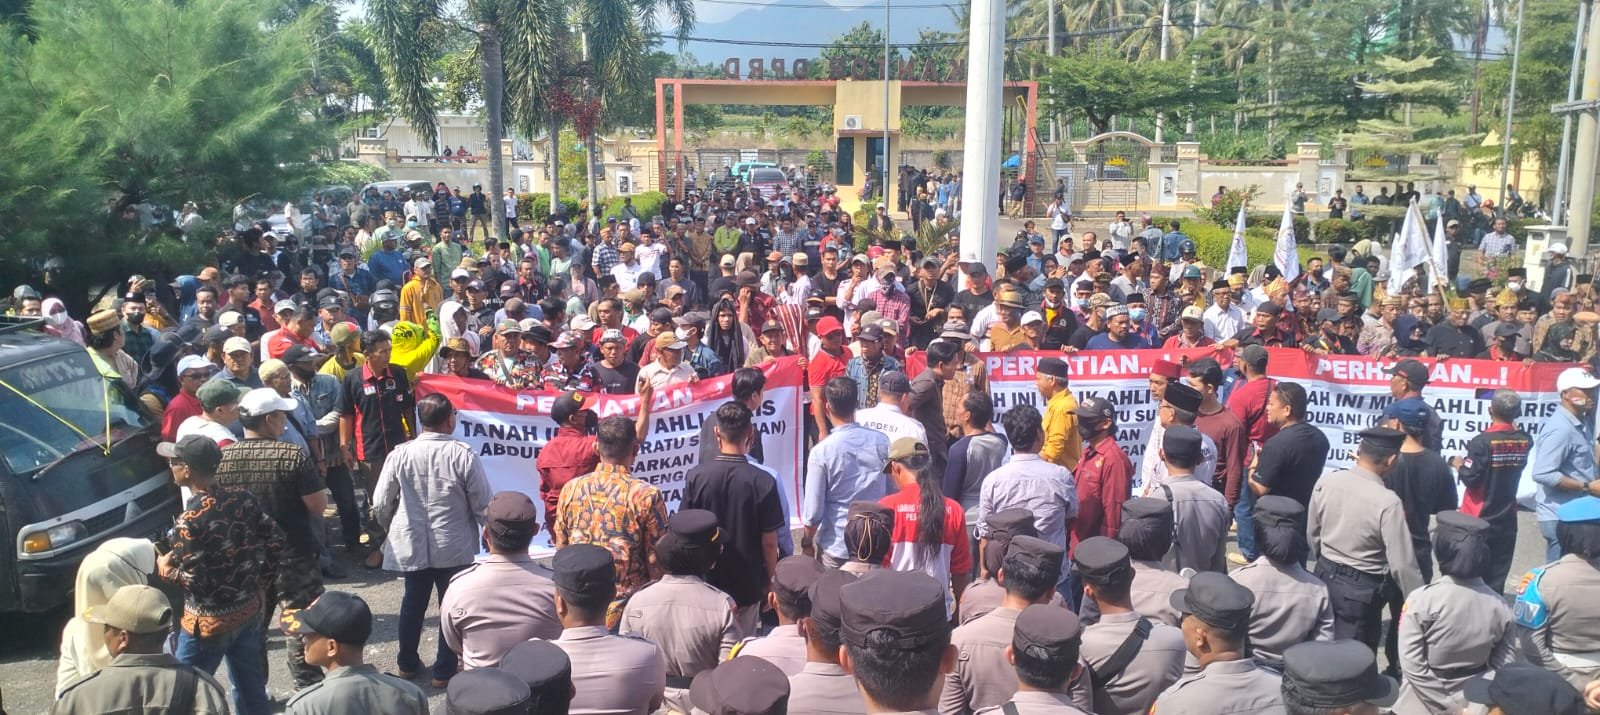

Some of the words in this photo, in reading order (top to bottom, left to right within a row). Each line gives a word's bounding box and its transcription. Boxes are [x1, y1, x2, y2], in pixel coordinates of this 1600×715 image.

[1011, 391, 1037, 408] INI
[1106, 389, 1151, 406] AHLI
[1335, 393, 1365, 409] INI
[1433, 398, 1483, 416] AHLI
[461, 420, 538, 441] TANAH
[655, 412, 704, 434] AHLI
[863, 421, 899, 433] APDESI
